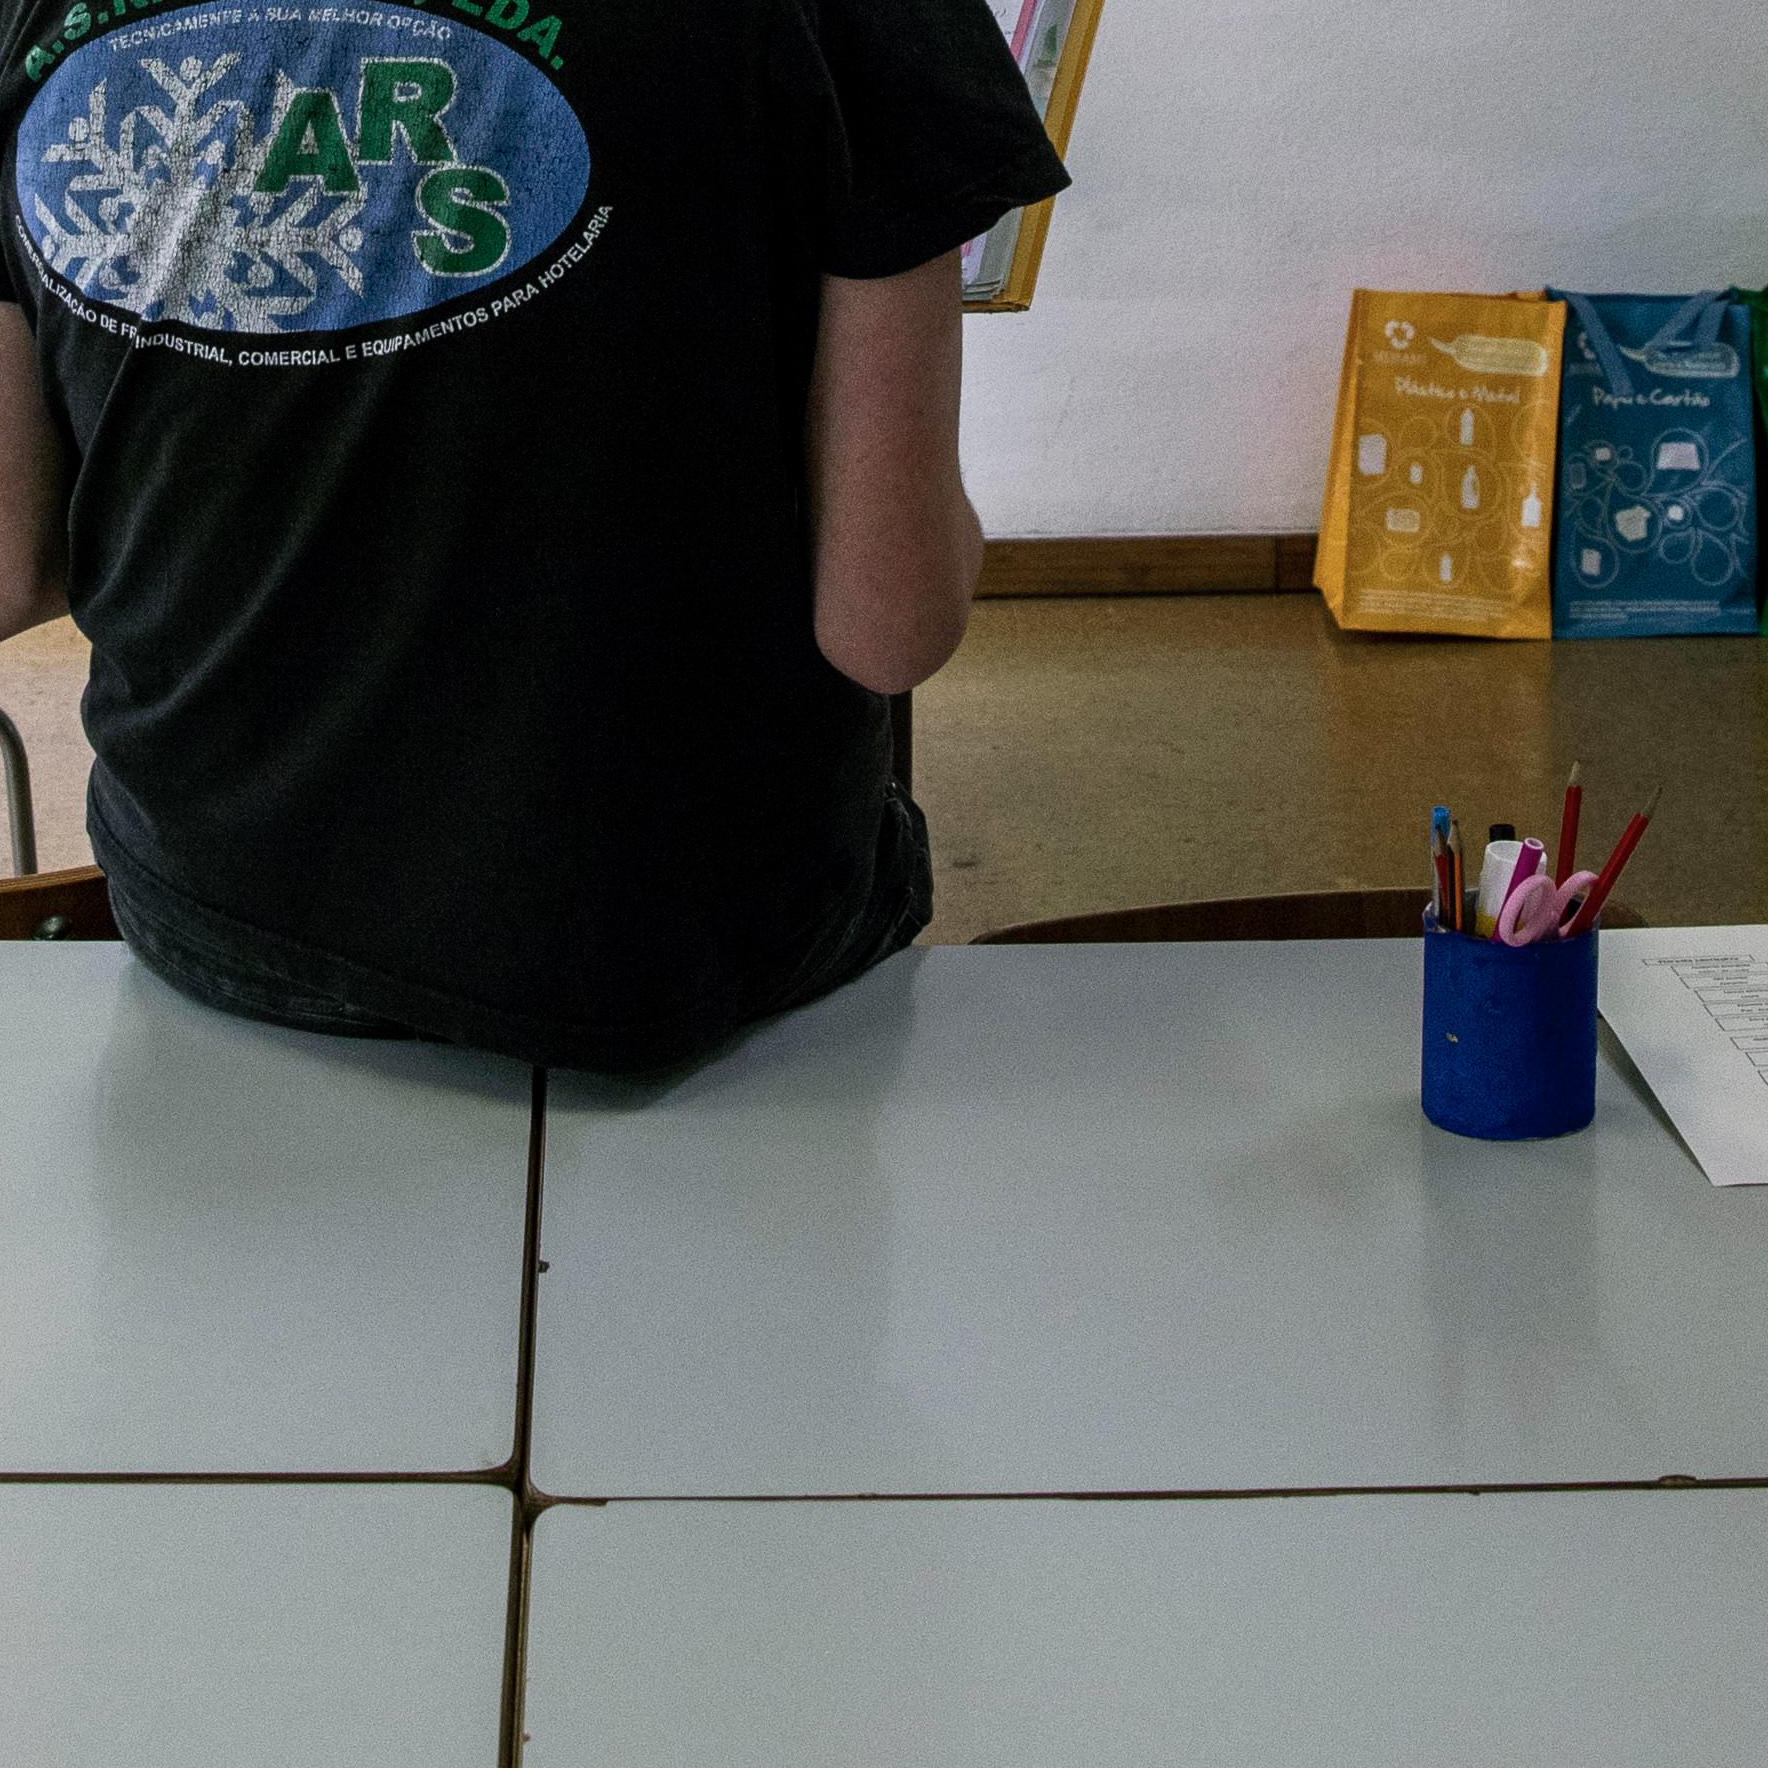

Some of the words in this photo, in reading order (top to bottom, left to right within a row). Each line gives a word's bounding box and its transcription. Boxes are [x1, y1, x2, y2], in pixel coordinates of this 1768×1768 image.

[109, 8, 242, 52] TECNICAMENTE
[265, 7, 302, 24] SUA
[308, 7, 382, 29] MELHOR
[100, 313, 119, 334] DE
[238, 349, 340, 367] COMERCIAL
[345, 343, 358, 360] E
[362, 306, 489, 358] EQUIPAMENTOS
[491, 282, 540, 318] PARA
[538, 204, 614, 289] HOTELARIA
